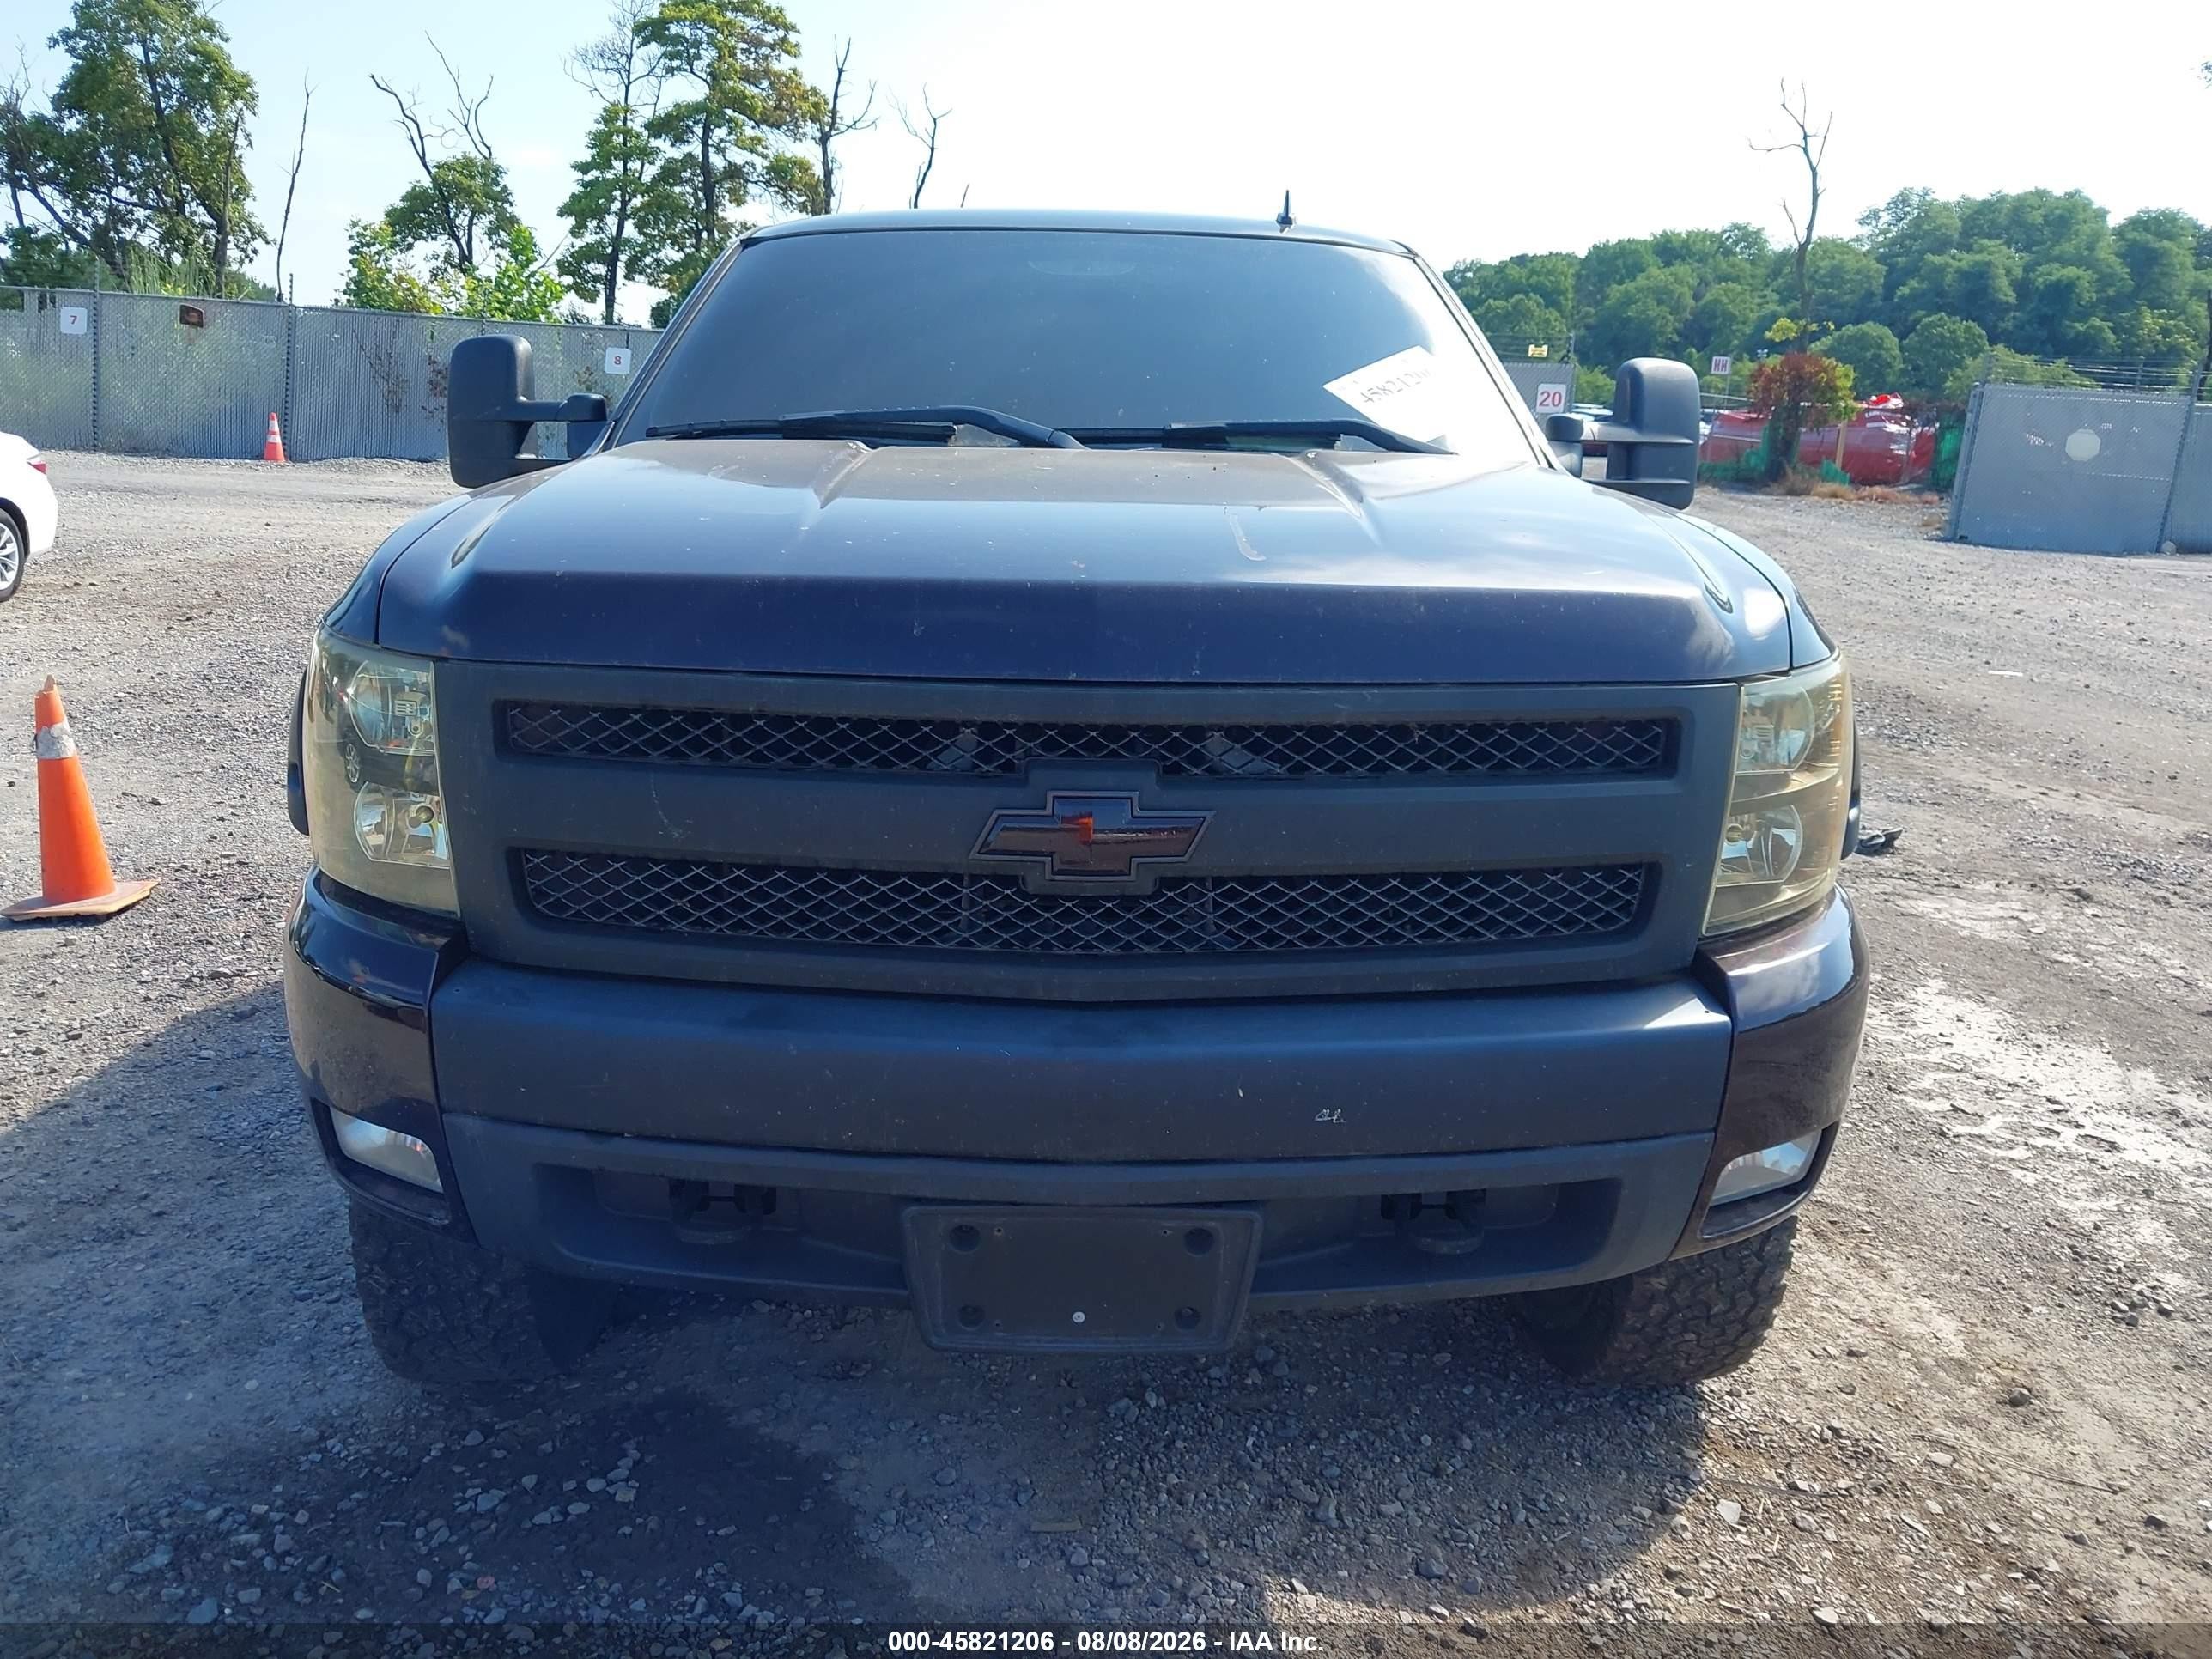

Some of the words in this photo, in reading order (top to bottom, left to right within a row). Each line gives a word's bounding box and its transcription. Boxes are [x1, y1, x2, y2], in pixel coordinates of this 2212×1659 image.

[70, 315, 78, 325] 7
[613, 356, 622, 365] 8
[1539, 391, 1562, 407] 20
